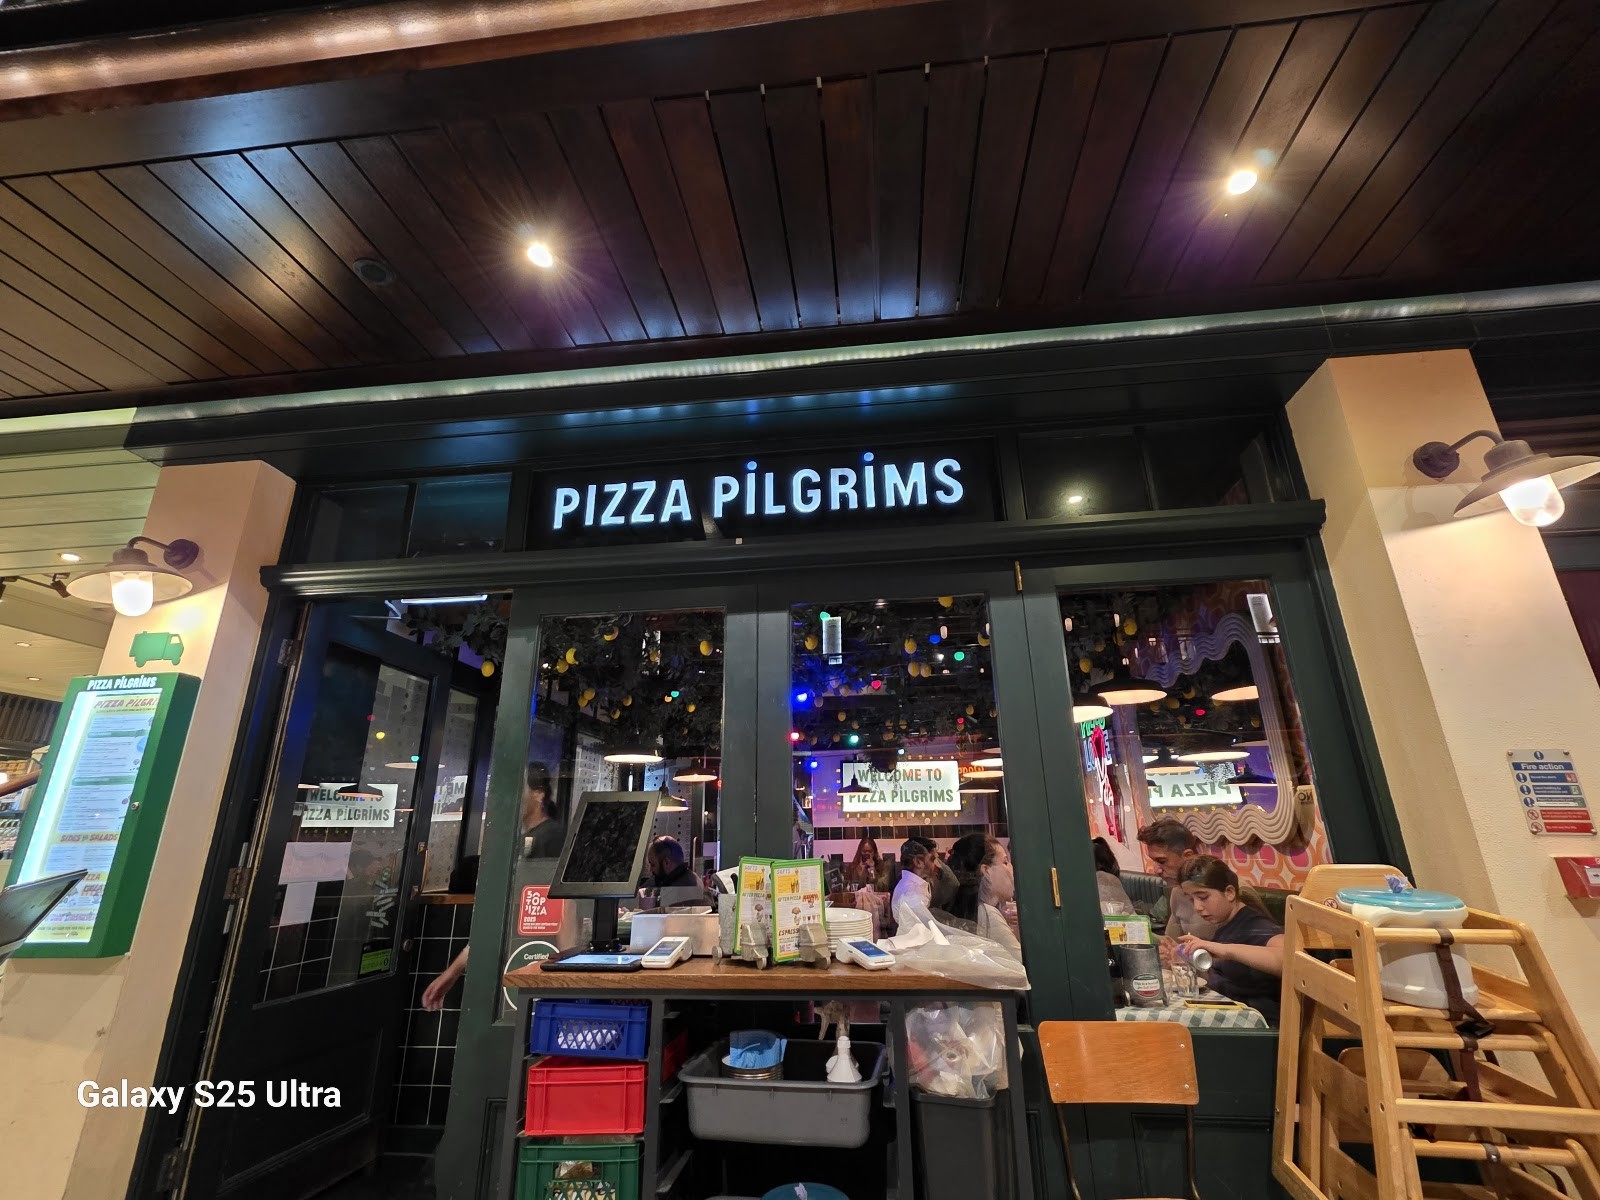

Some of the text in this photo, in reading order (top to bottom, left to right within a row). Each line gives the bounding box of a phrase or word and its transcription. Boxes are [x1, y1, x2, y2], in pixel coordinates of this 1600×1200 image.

[553, 479, 692, 530] PIZZA
[87, 679, 113, 690] PIZZA
[94, 700, 125, 709] PIZZA
[925, 768, 942, 782] TO
